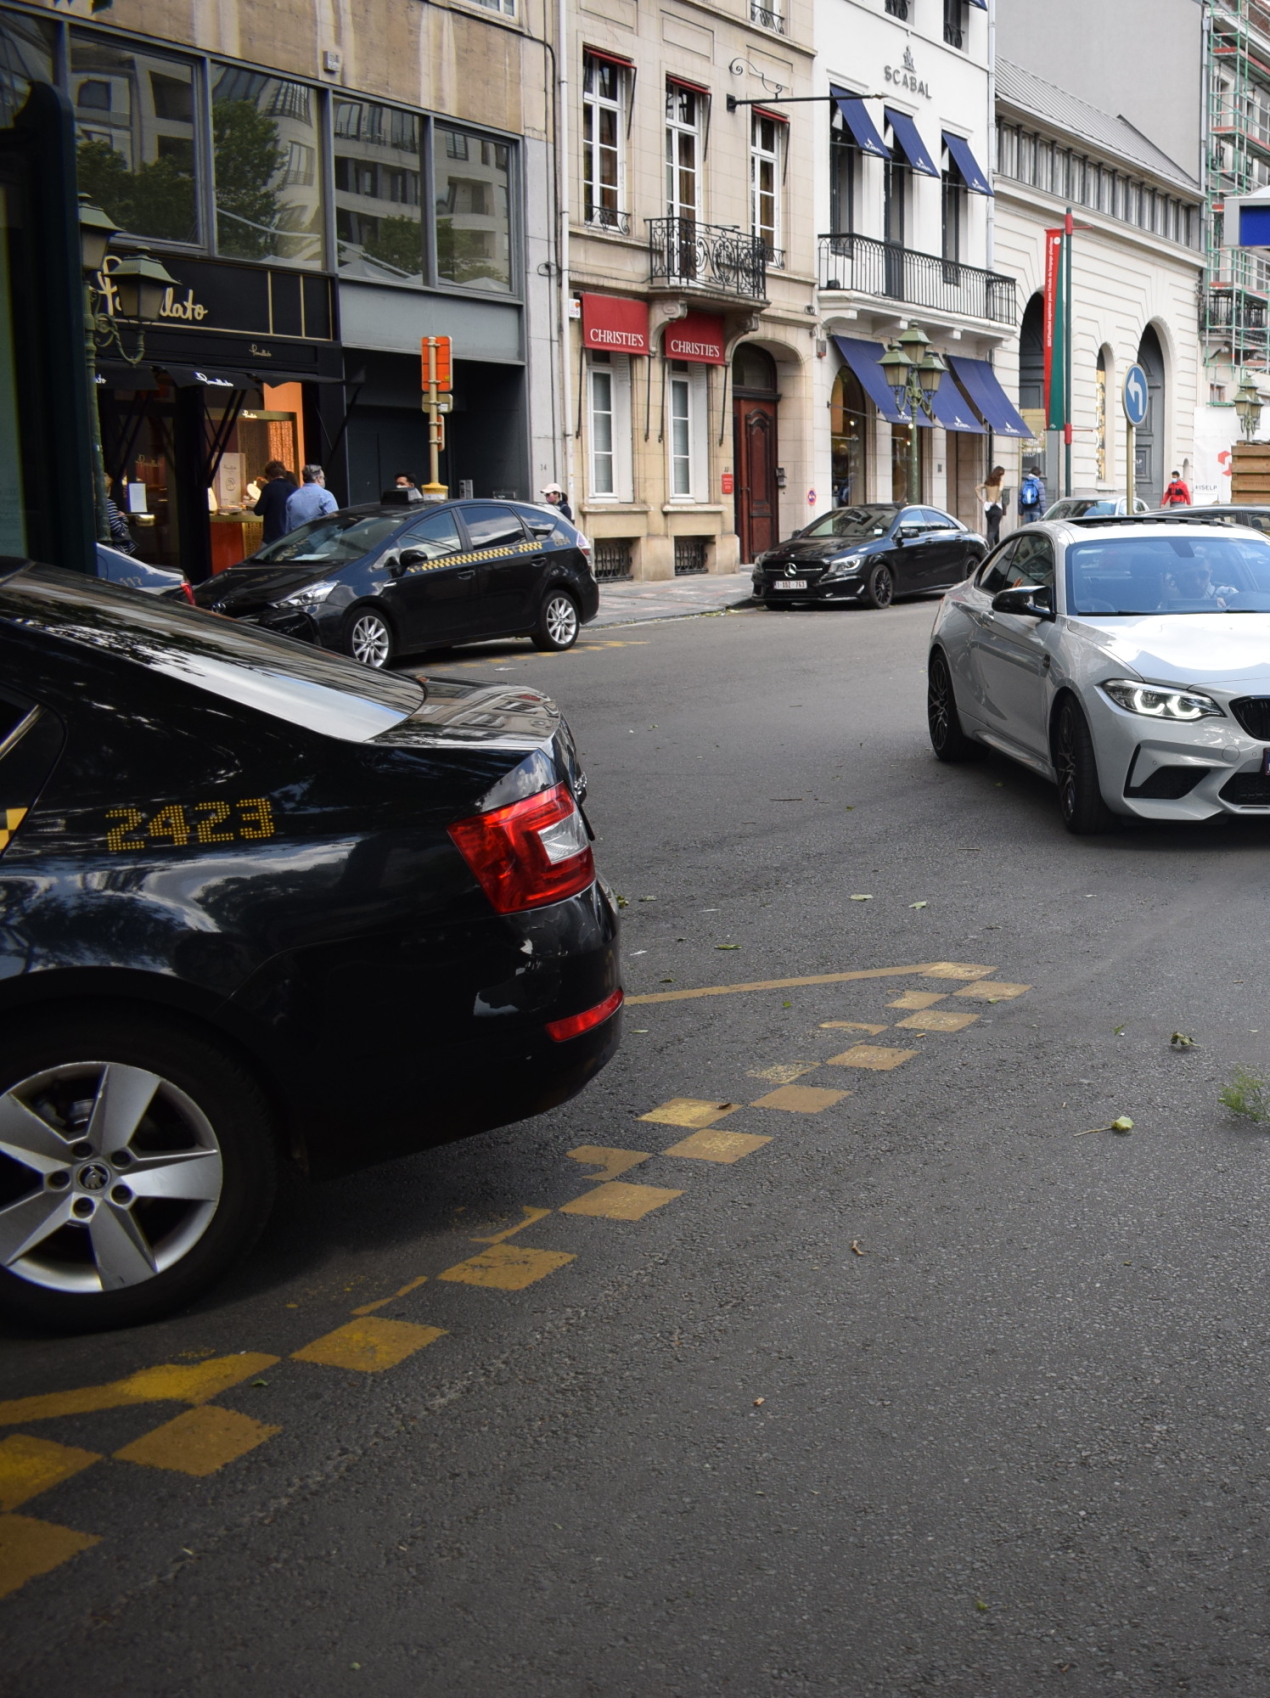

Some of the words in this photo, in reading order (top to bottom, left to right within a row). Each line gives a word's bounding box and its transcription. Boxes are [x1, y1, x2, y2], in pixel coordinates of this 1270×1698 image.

[884, 65, 932, 99] SCABAL
[590, 328, 644, 347] CHRISTIE'S
[670, 339, 720, 358] CHRISTIE'S
[105, 798, 275, 851] 2423
